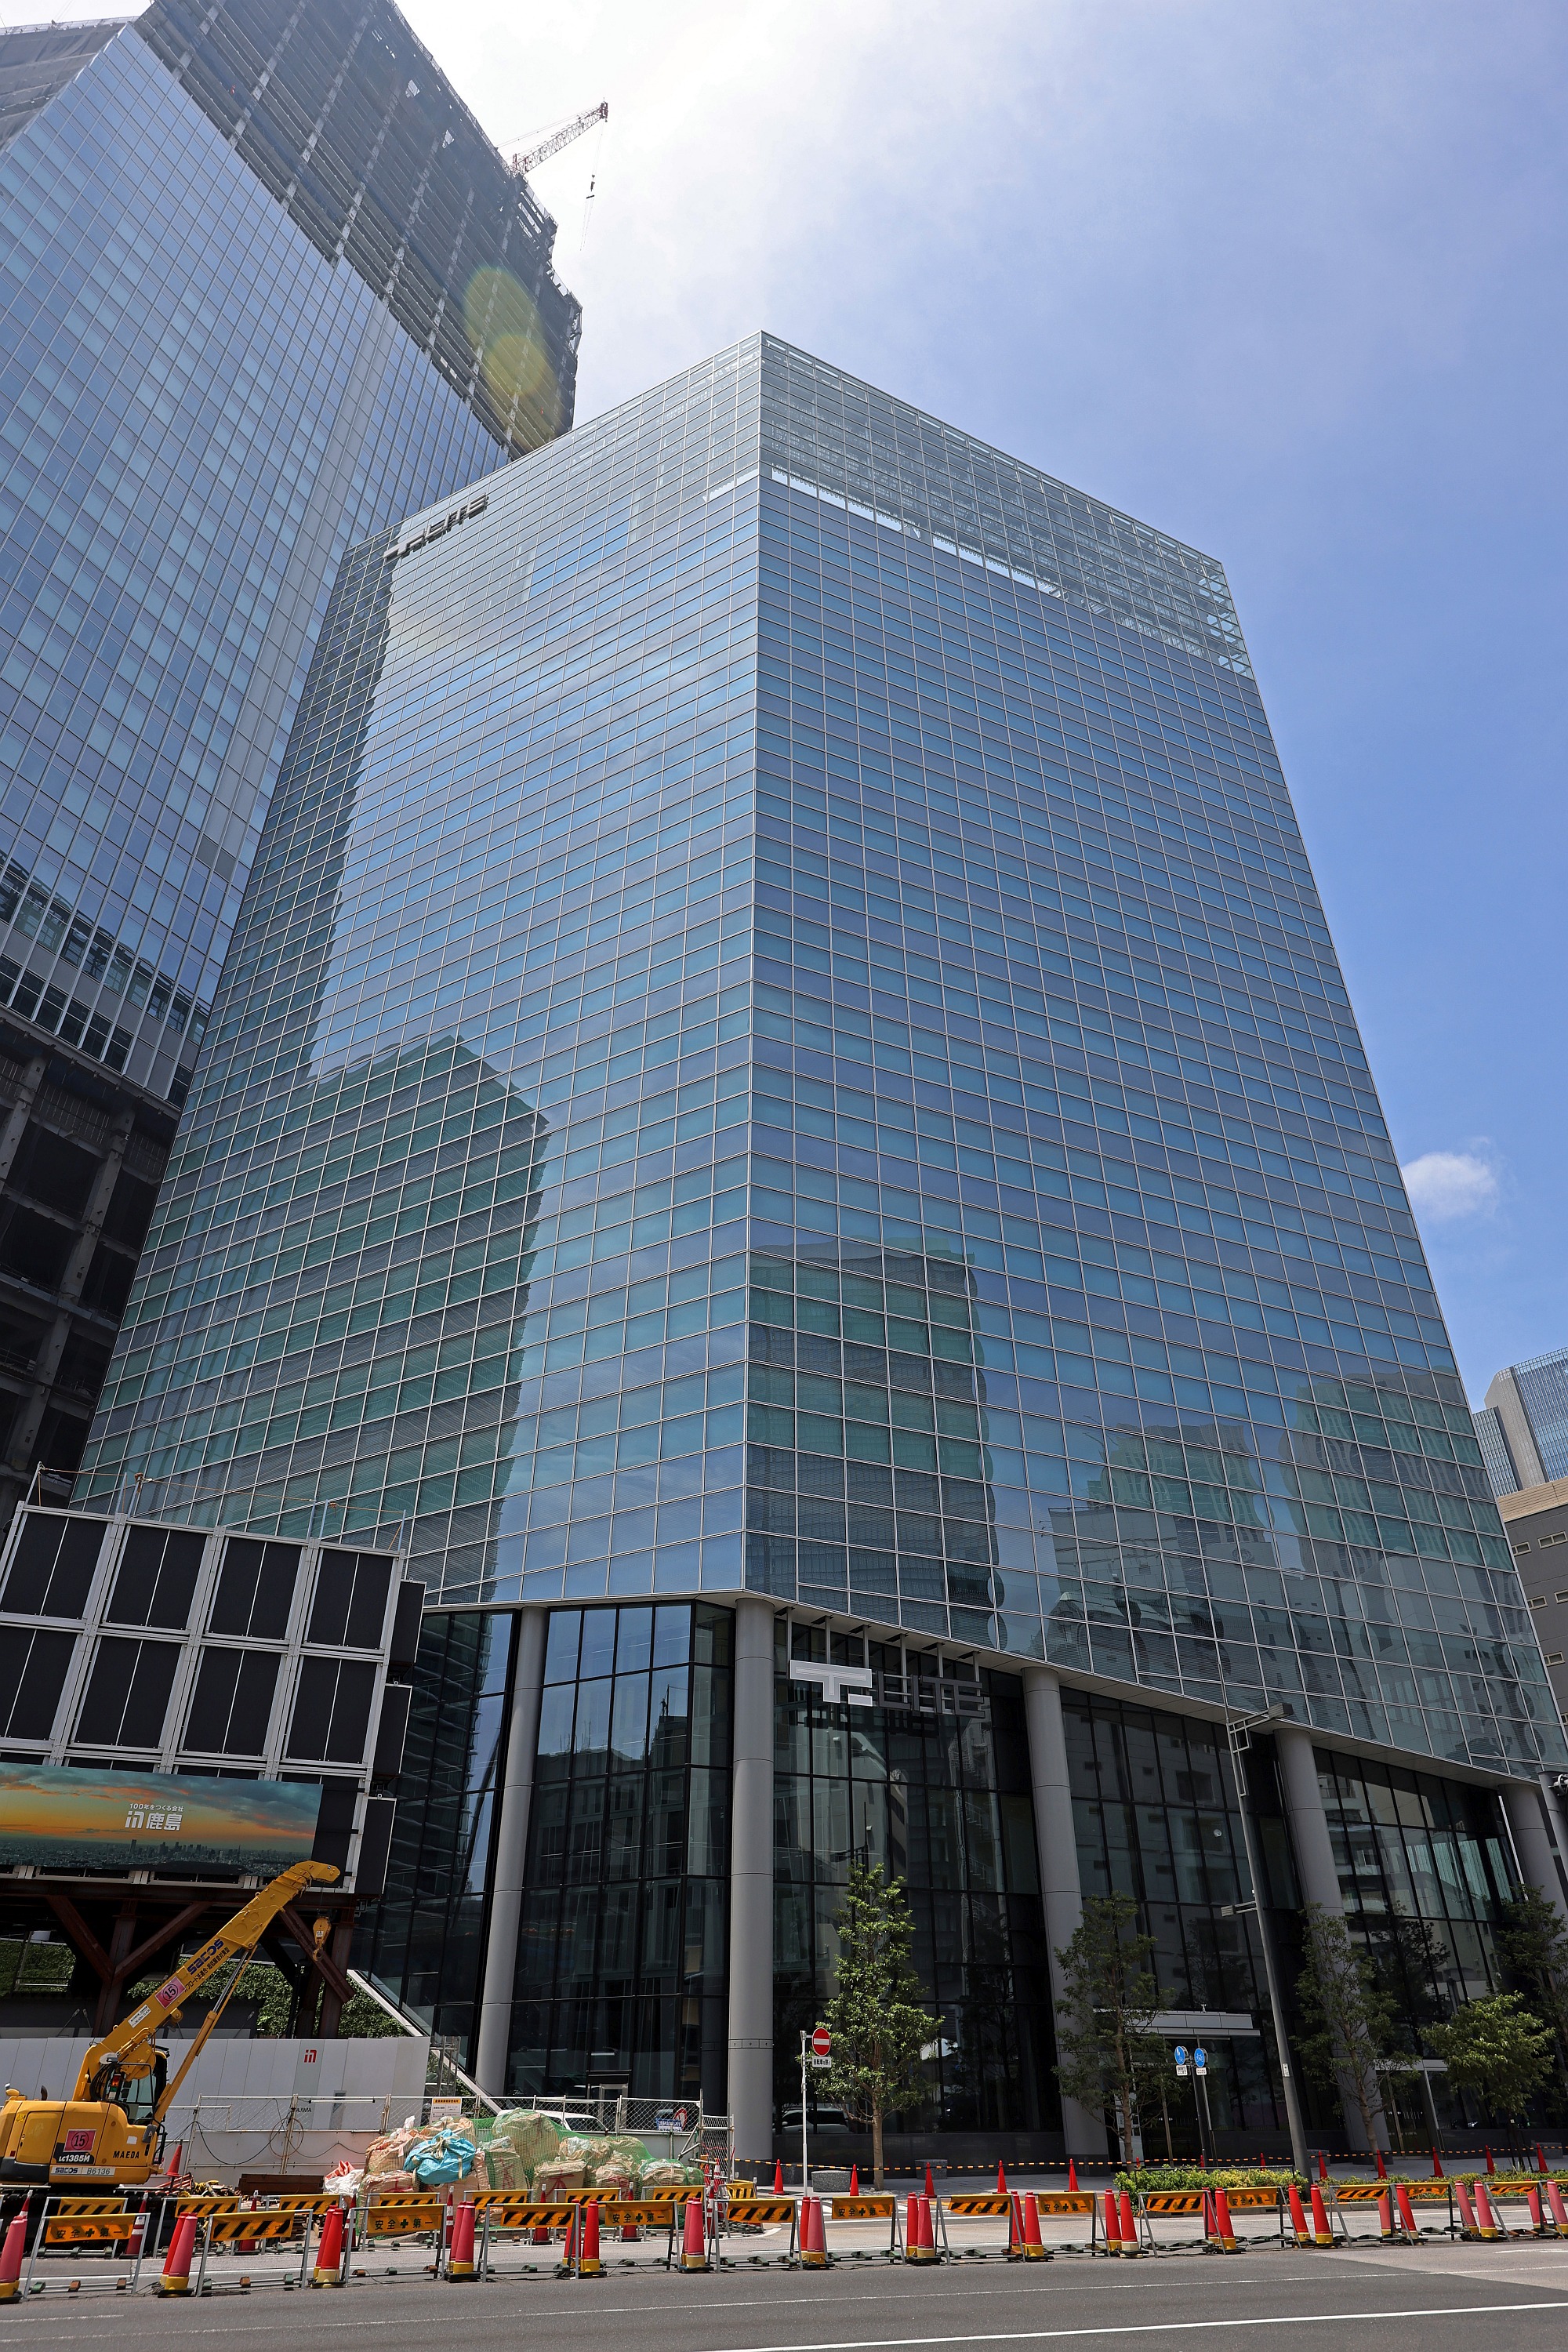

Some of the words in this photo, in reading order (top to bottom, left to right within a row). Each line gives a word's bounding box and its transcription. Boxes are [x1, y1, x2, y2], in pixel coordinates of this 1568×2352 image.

[789, 1660, 985, 1719] T-LITE
[129, 1803, 184, 1812] 100年をつくる会社
[146, 1812, 183, 1831] 鹿島
[112, 2151, 140, 2159] MAEDA
